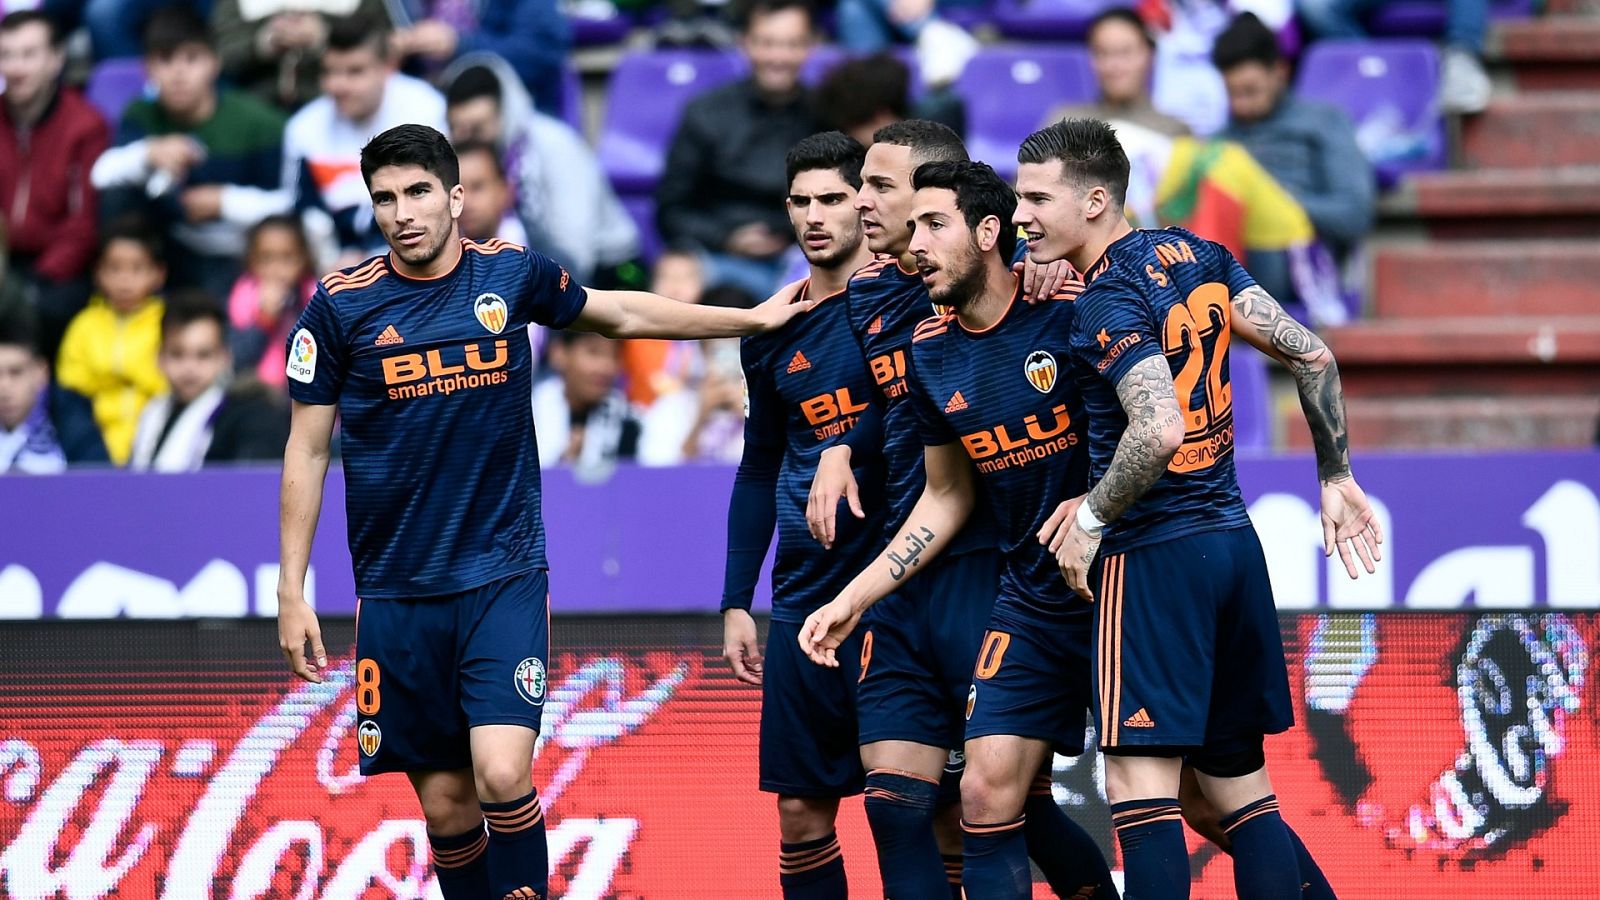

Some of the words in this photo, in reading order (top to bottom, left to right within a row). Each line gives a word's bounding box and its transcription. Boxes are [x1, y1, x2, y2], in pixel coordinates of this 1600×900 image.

[375, 336, 404, 346] adidas
[1163, 282, 1232, 438] 22
[388, 370, 508, 400] smartphones
[814, 415, 861, 441] smart
[976, 432, 1079, 475] smartphones
[356, 658, 381, 716] 8
[1123, 720, 1155, 728] adidas
